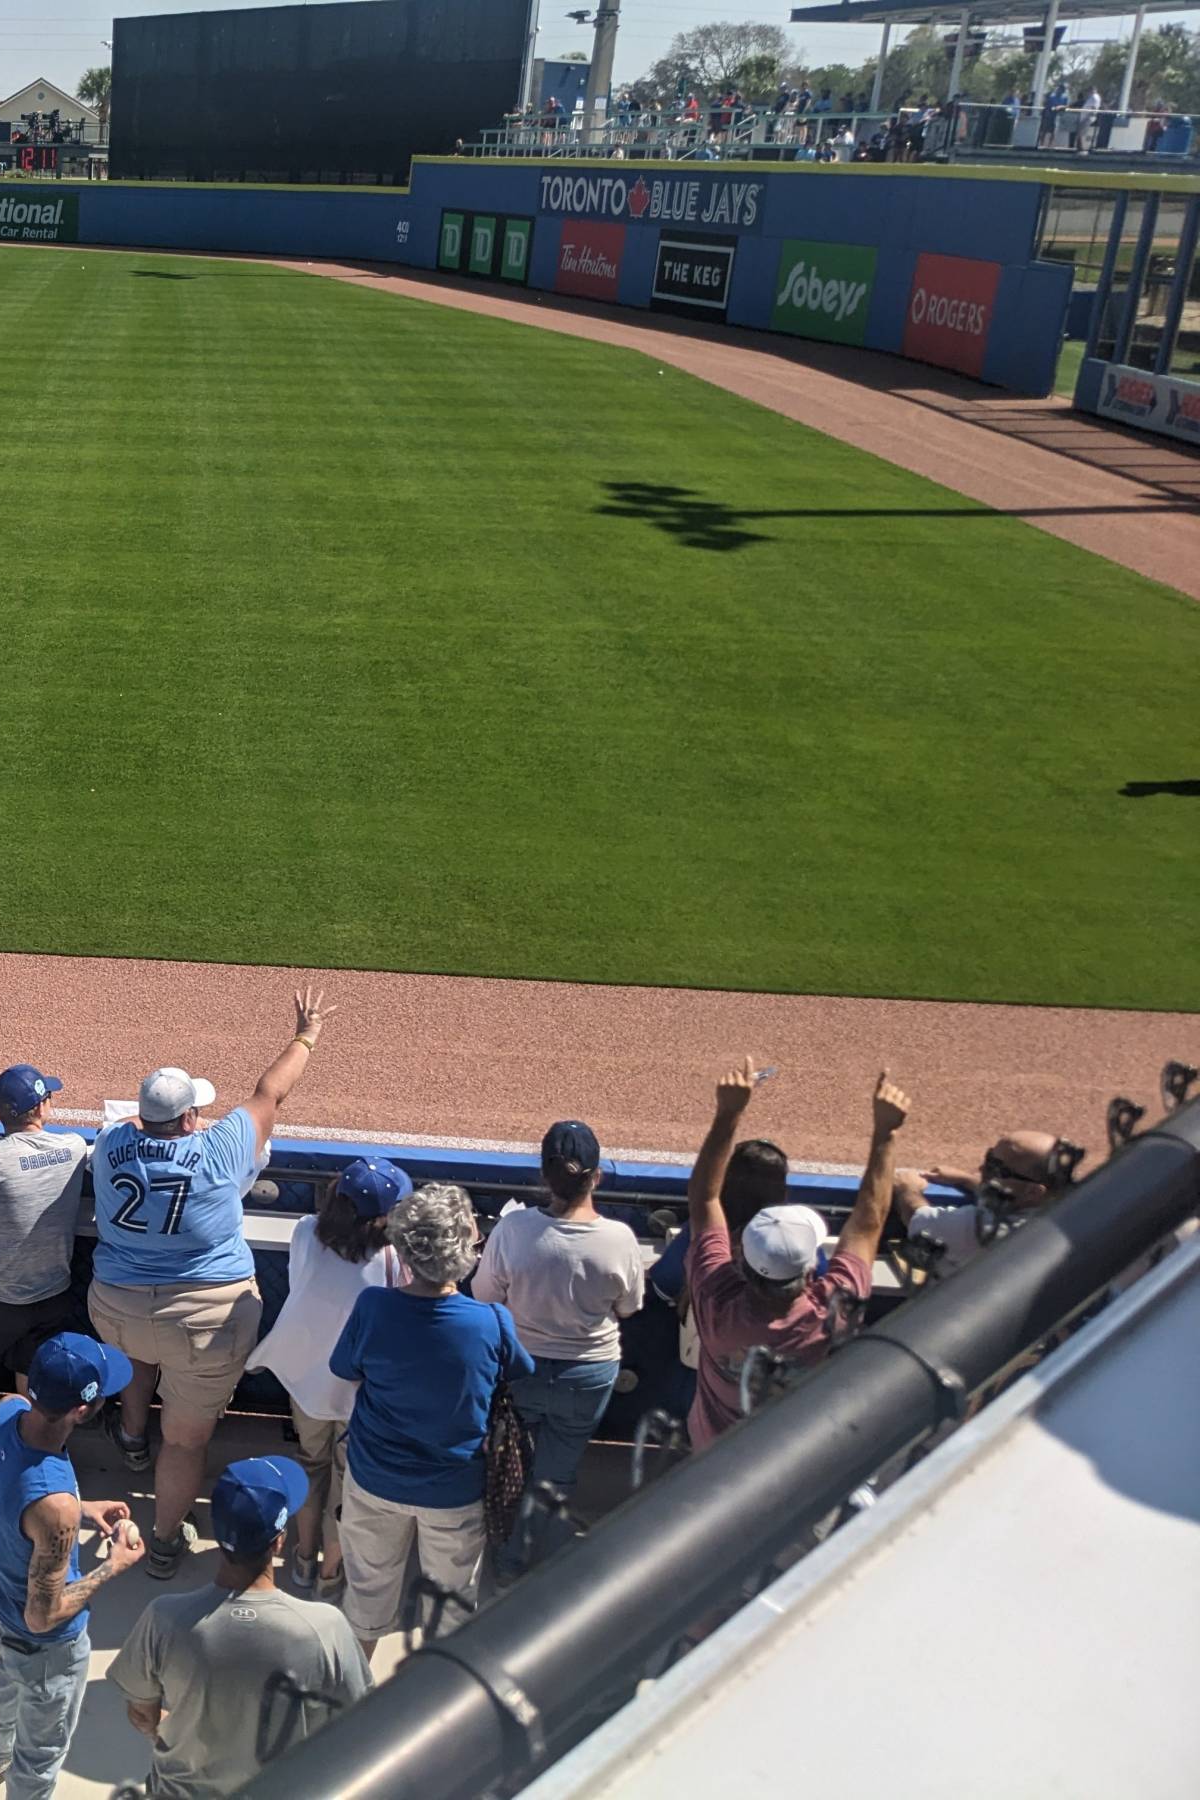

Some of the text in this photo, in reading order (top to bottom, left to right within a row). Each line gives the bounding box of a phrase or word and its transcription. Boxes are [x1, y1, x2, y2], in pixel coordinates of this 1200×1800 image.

[541, 176, 760, 226] TORONTO BLUE JAYS
[0, 226, 58, 239] Car Rental
[560, 244, 617, 279] Tim Hortons
[664, 260, 721, 287] THE KEG
[777, 261, 867, 321] Sobeys
[927, 294, 985, 335] ROGERS
[176, 1151, 201, 1174] JR.
[110, 1173, 192, 1235] 27
